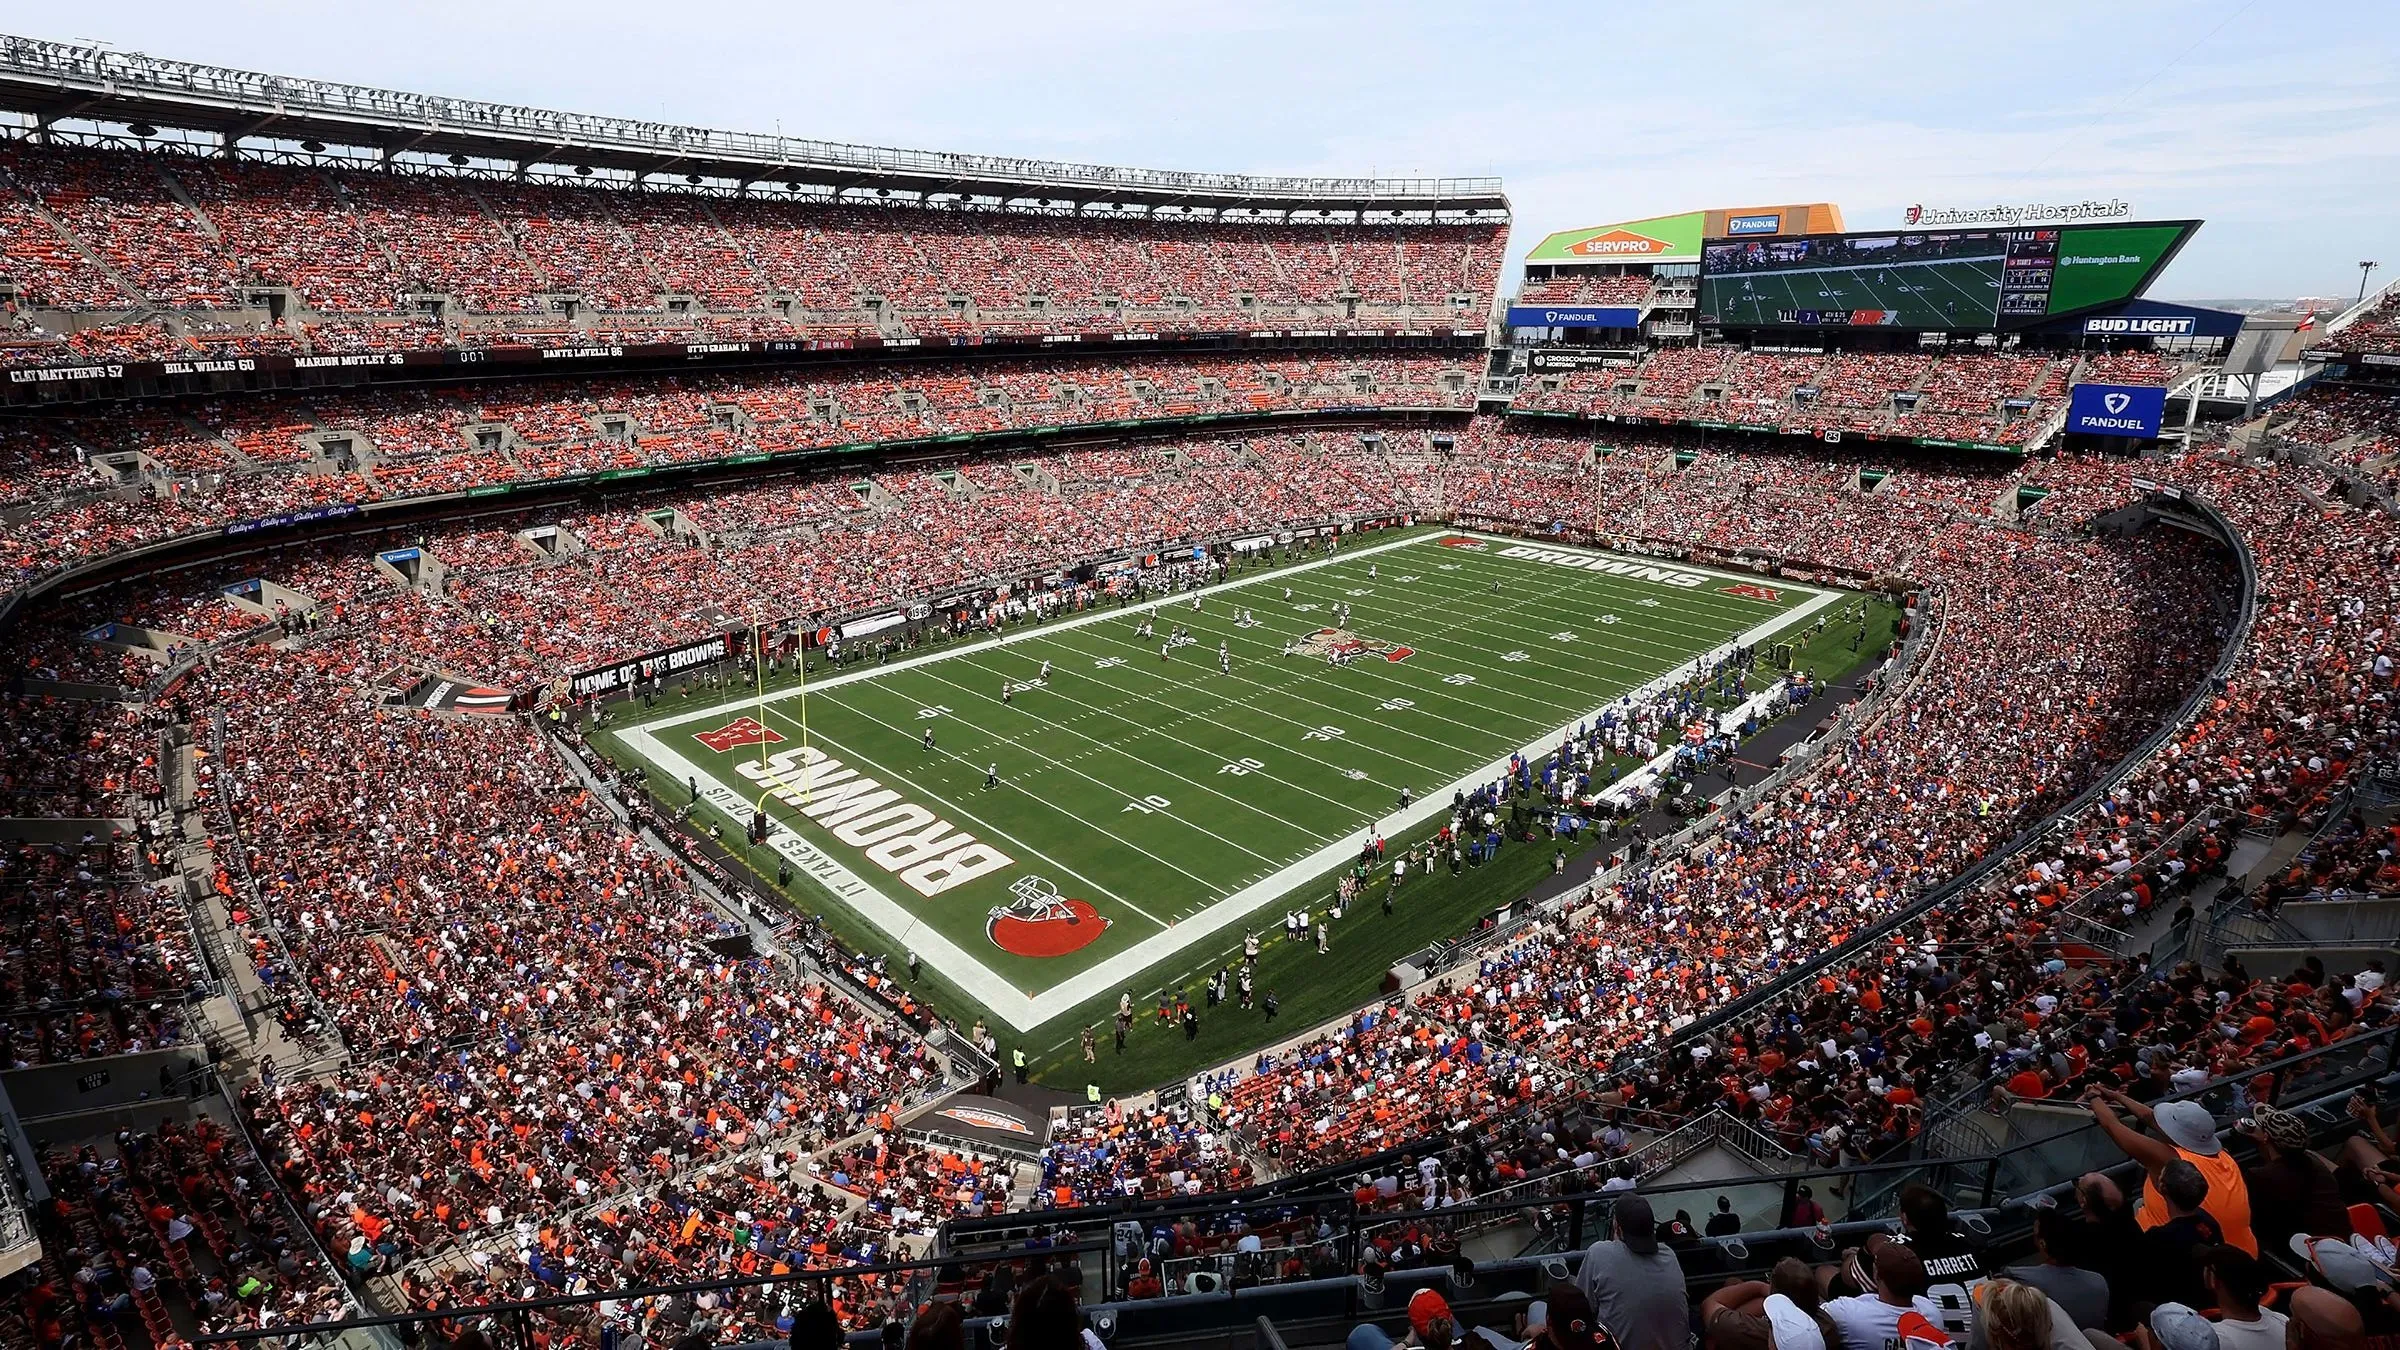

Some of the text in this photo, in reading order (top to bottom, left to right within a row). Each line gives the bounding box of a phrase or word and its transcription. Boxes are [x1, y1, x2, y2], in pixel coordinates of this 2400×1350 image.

[1922, 199, 2128, 226] University Hospitals
[1741, 220, 1778, 230] FANDUEL
[1586, 240, 1650, 253] SERVPRO
[2072, 255, 2141, 266] Huntington Bank
[1558, 313, 1598, 322] FANDUEL
[1806, 313, 1811, 321] 7
[1861, 313, 1866, 321] 7
[2087, 318, 2192, 333] BUD LIGHT
[543, 348, 573, 358] DANTE
[573, 347, 610, 357] LAVELLI
[687, 343, 750, 353] OTTO GRAHAM 14
[164, 359, 255, 374] BILL WILLIS 60
[294, 353, 404, 368] MARION MOTLEY 36
[1546, 355, 1602, 364] CROSSCOUNTRY
[10, 366, 124, 383] CLAY MATTHEWS 57
[2082, 416, 2145, 430] FANDUEL
[1827, 432, 1838, 440] 25
[1495, 546, 1710, 588] BROWNS
[574, 668, 618, 696] HOME
[669, 640, 725, 670] BROWNS
[1443, 673, 1476, 686] 50
[1382, 697, 1415, 711] 40
[1312, 724, 1346, 741] 30
[1226, 757, 1264, 776] 20
[1130, 794, 1171, 814] 10
[734, 745, 1017, 898] BROWNS
[705, 787, 868, 897] IT TAKES OF US
[955, 1110, 1013, 1129] SERVPRO
[1116, 1229, 1133, 1242] 24
[1924, 1253, 1979, 1277] GARRETT
